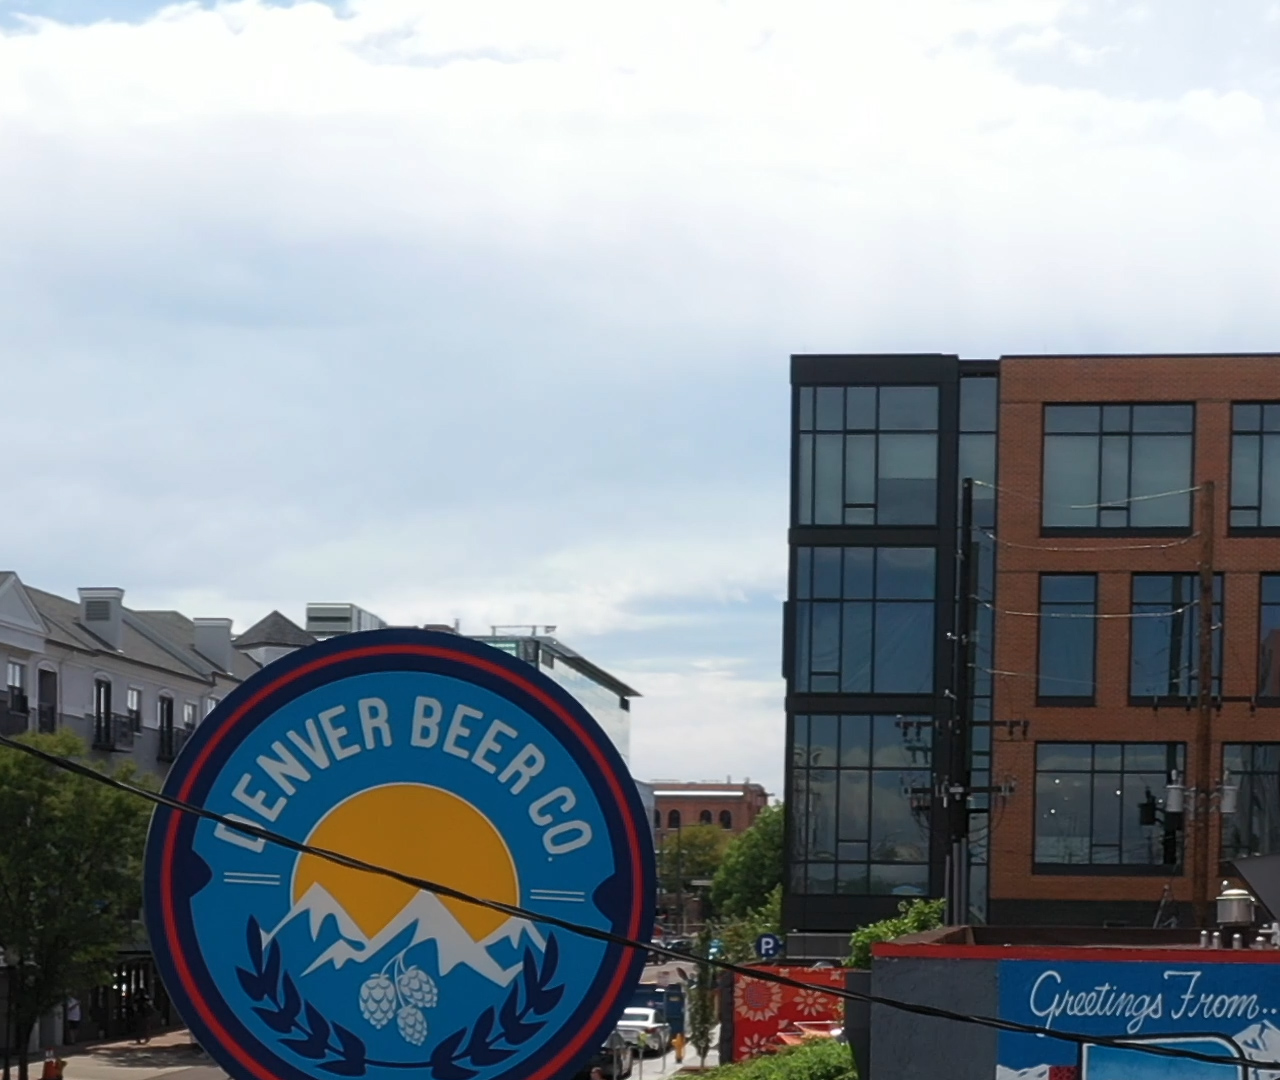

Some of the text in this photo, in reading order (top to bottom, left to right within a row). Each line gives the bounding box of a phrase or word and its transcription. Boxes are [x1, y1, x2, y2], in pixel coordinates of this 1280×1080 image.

[214, 697, 392, 853] DENVER
[410, 696, 546, 796] BEER
[1030, 970, 1163, 1040] Greetings
